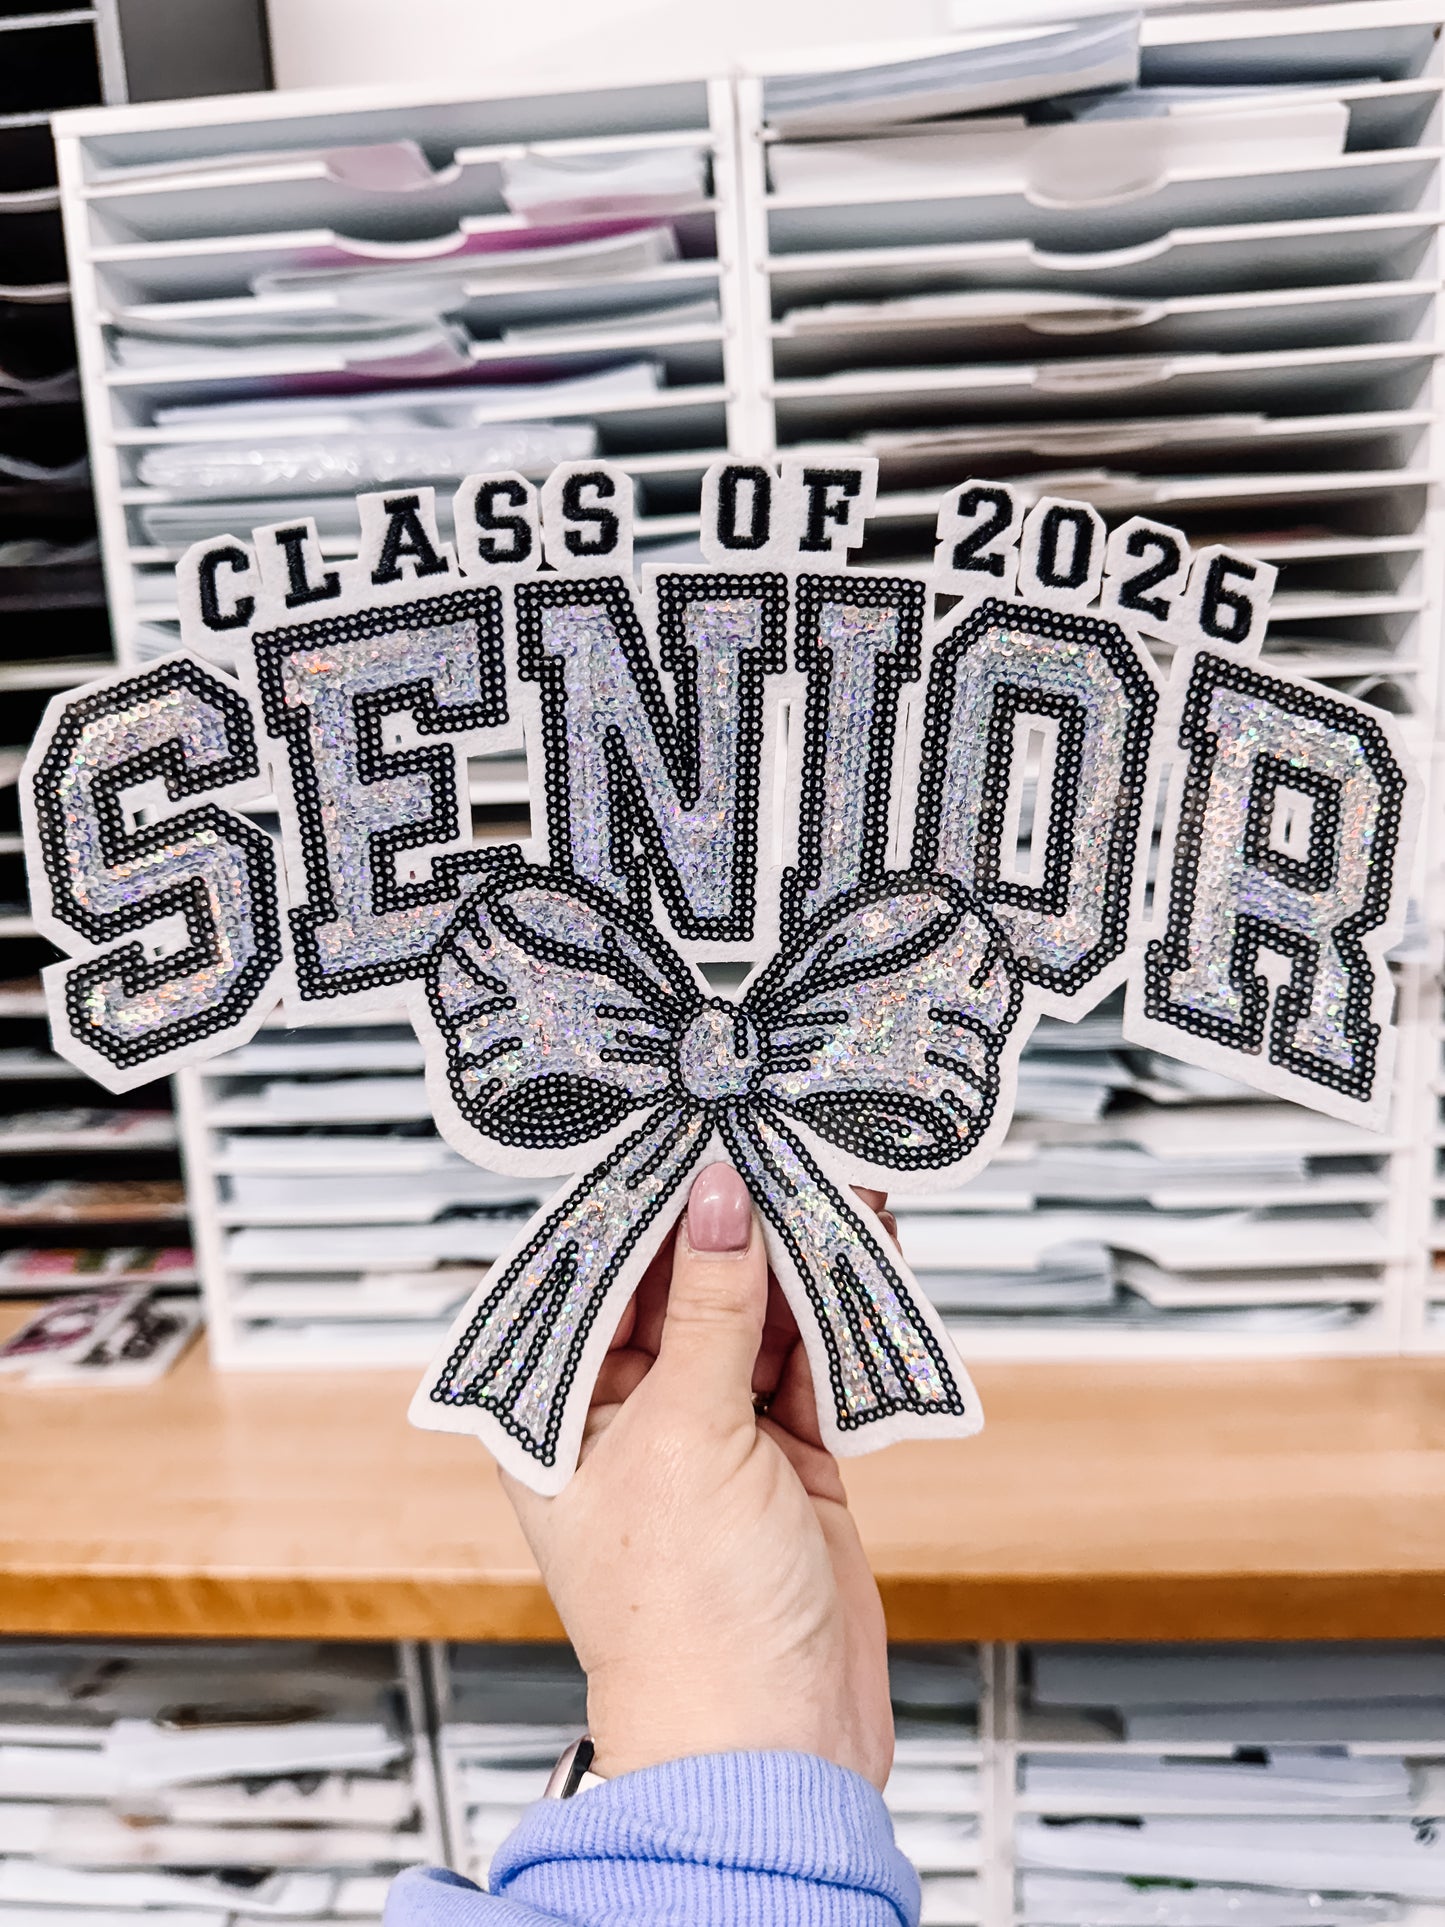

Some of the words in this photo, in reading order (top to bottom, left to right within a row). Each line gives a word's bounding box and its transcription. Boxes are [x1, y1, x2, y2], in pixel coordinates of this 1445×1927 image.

[199, 471, 619, 632] CLASS
[717, 465, 861, 553] OF
[953, 487, 1257, 645] 2026
[33, 572, 1406, 1103] SENIOR
